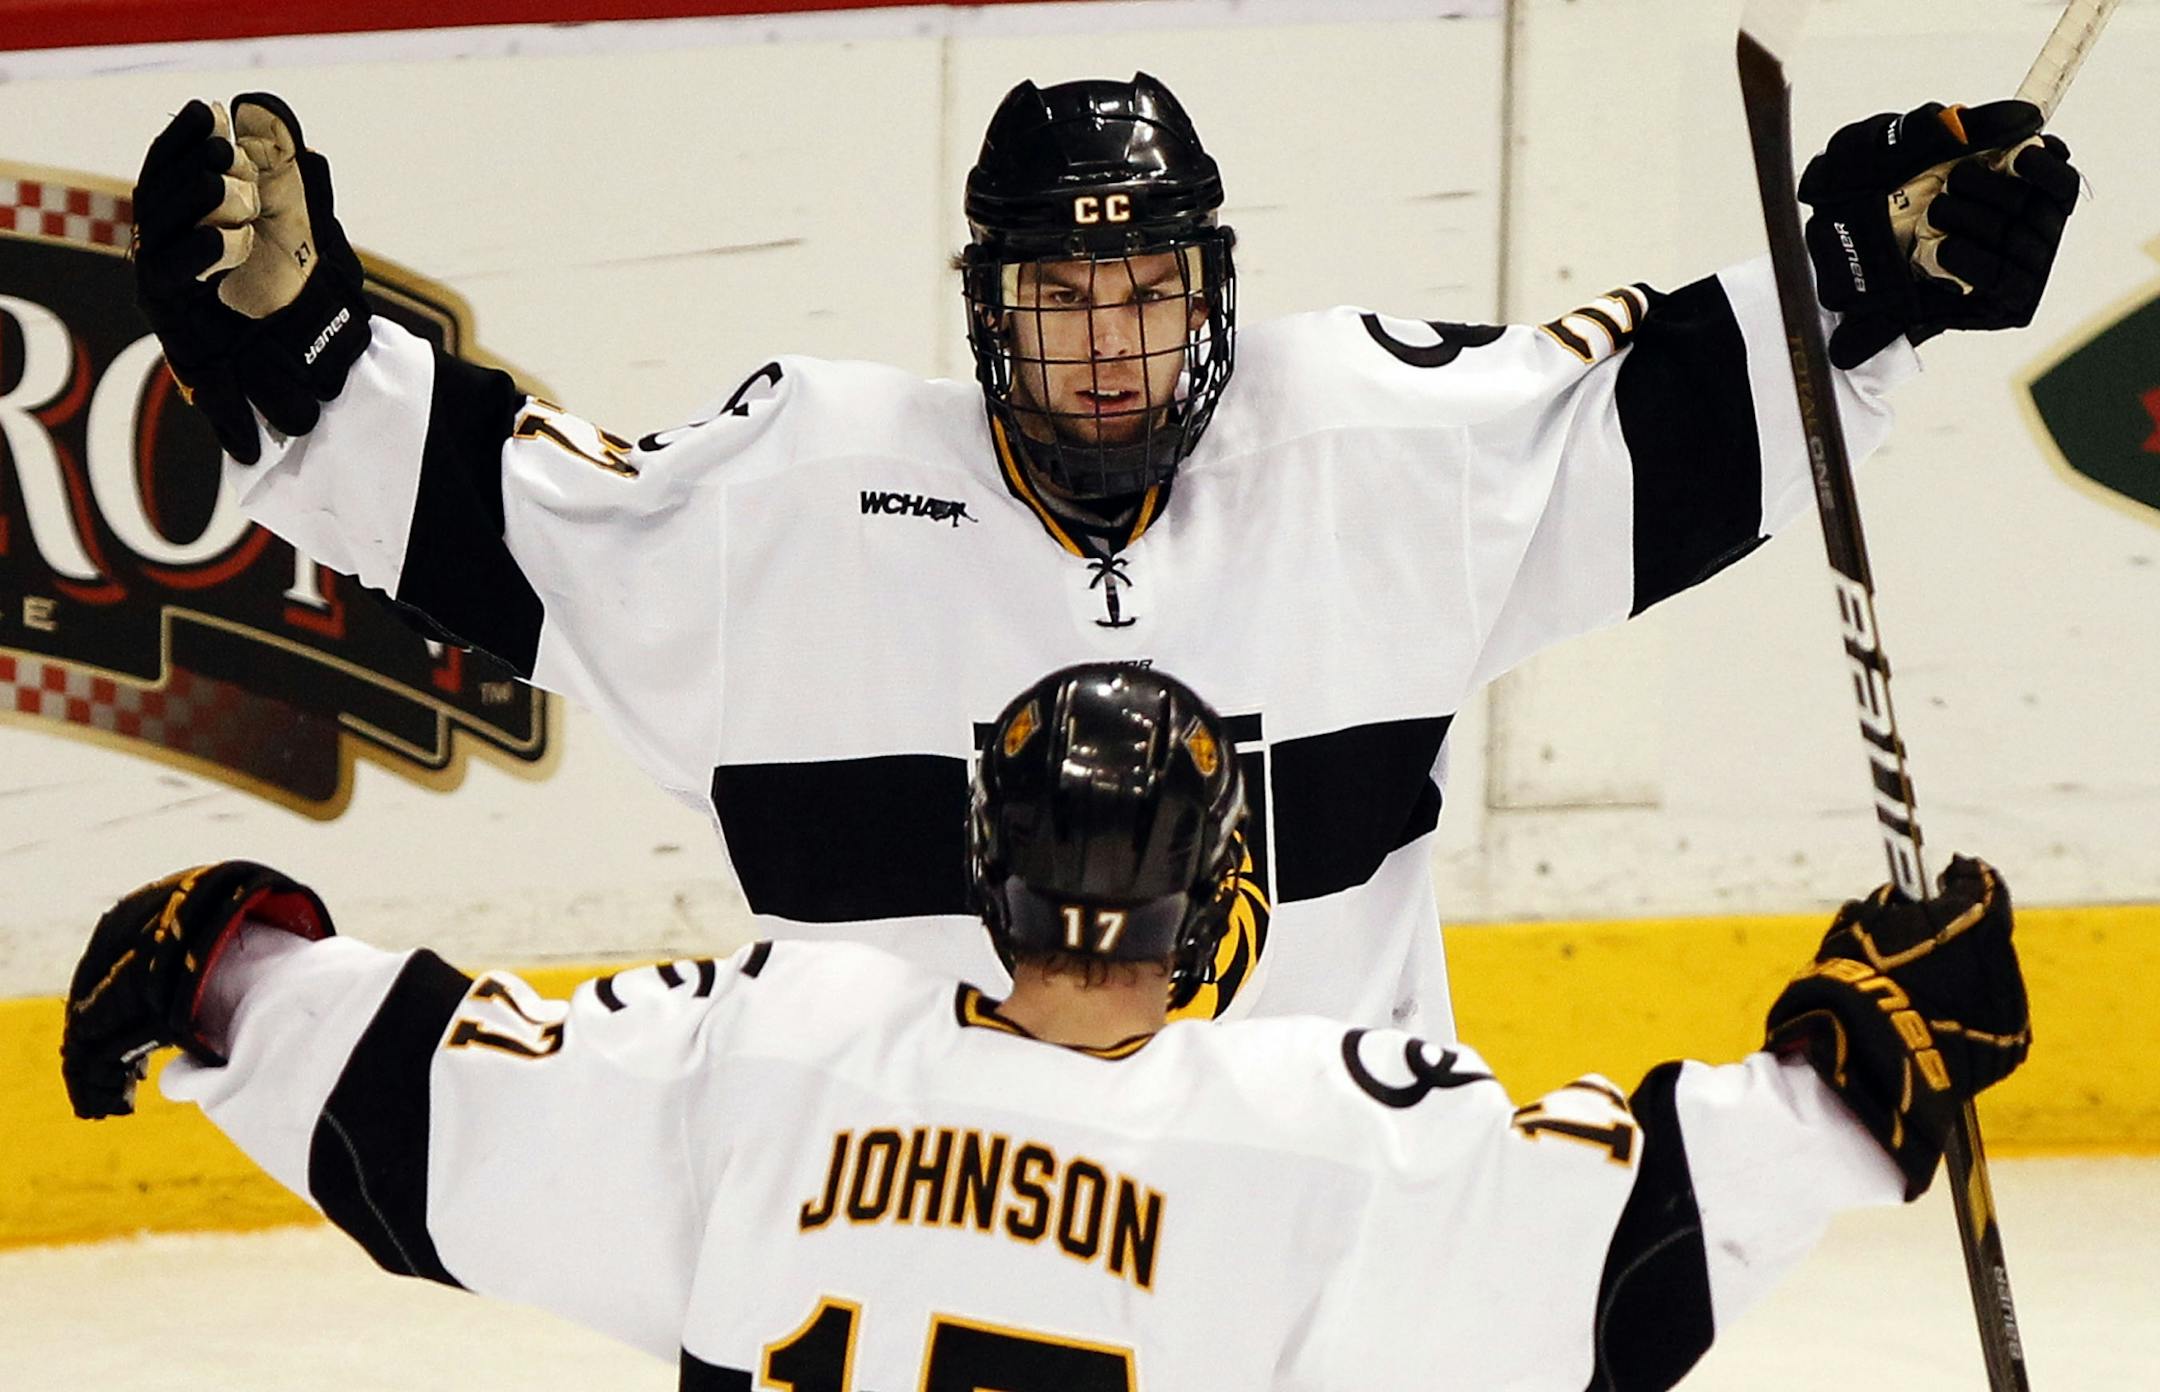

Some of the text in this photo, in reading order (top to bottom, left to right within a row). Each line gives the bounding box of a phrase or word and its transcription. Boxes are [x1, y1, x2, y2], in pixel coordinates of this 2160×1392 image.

[1074, 194, 1131, 224] CC
[1833, 221, 1867, 293] BAUER
[303, 306, 351, 365] BAUER
[1830, 570, 1924, 899] BAUE
[1061, 906, 1125, 953] 17
[798, 1125, 1168, 1294] JOHNSON
